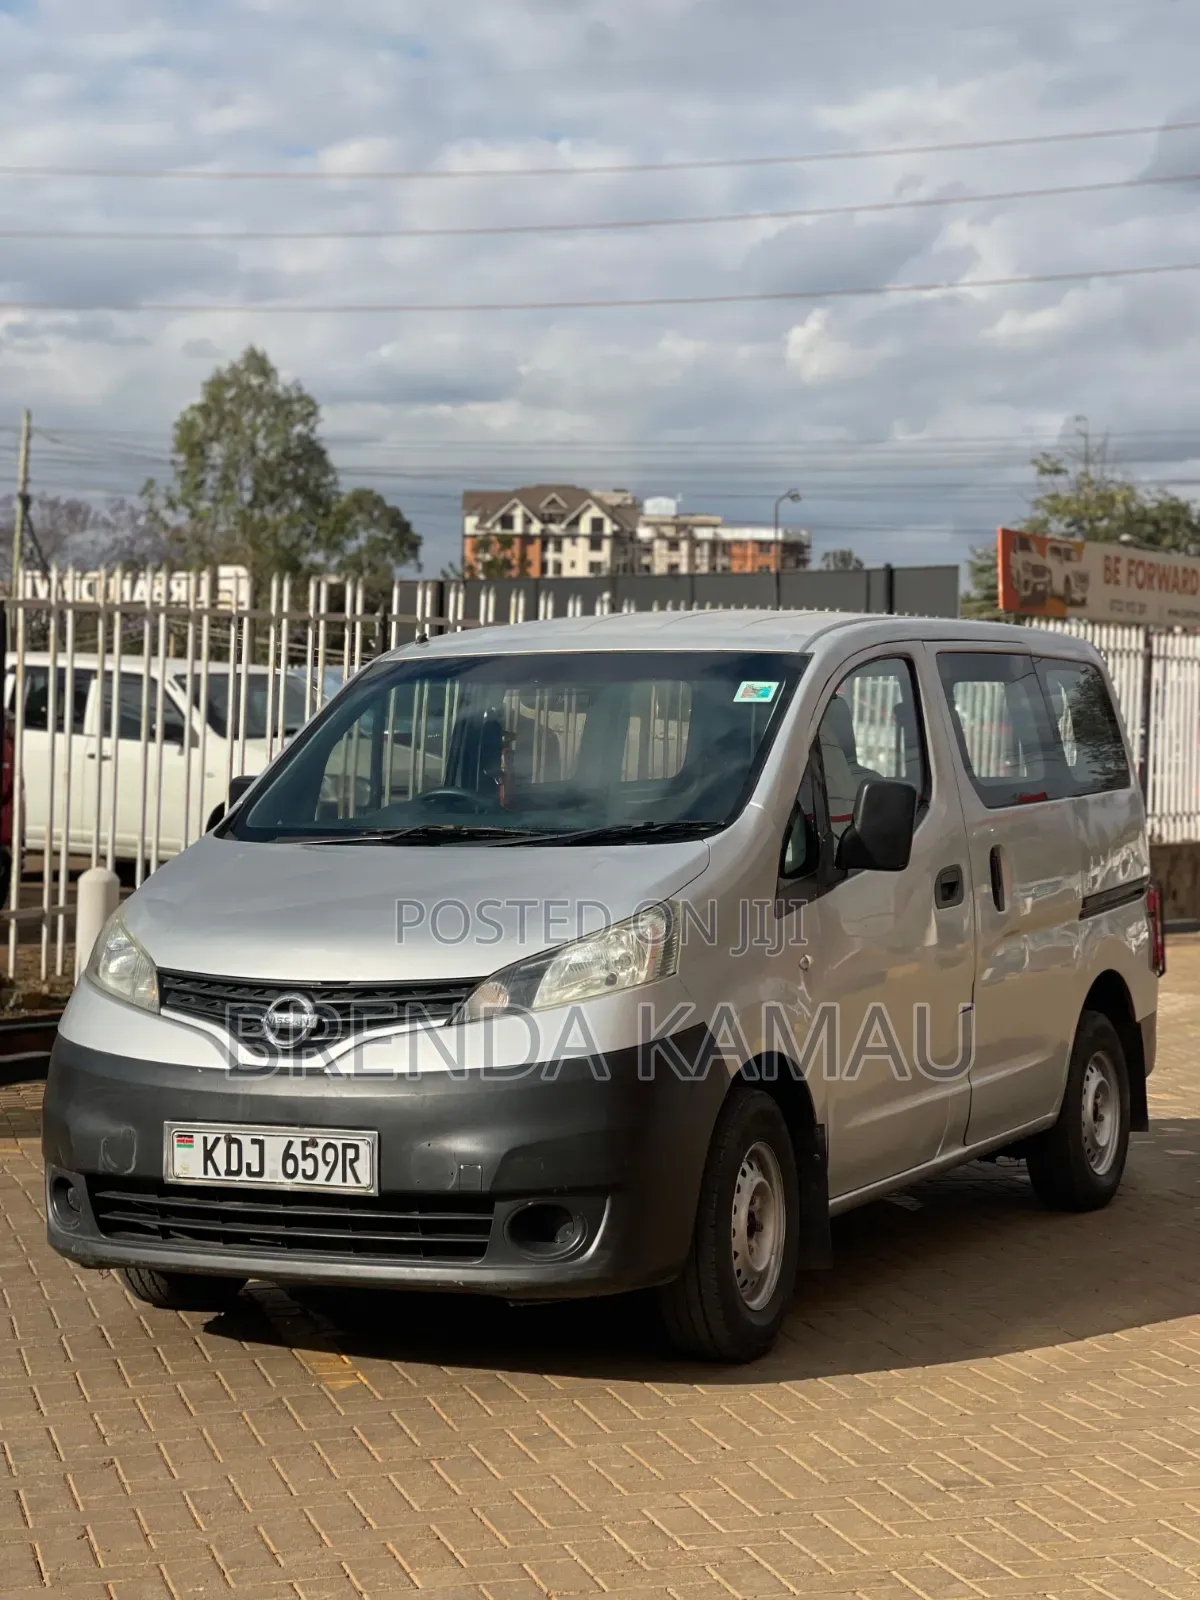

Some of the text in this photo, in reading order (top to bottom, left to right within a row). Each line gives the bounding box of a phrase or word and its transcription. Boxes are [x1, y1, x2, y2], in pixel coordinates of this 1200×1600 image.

[1103, 554, 1199, 596] BE FORWARD
[265, 1014, 311, 1027] NISSAN
[202, 1135, 362, 1184] KDJ 659R
